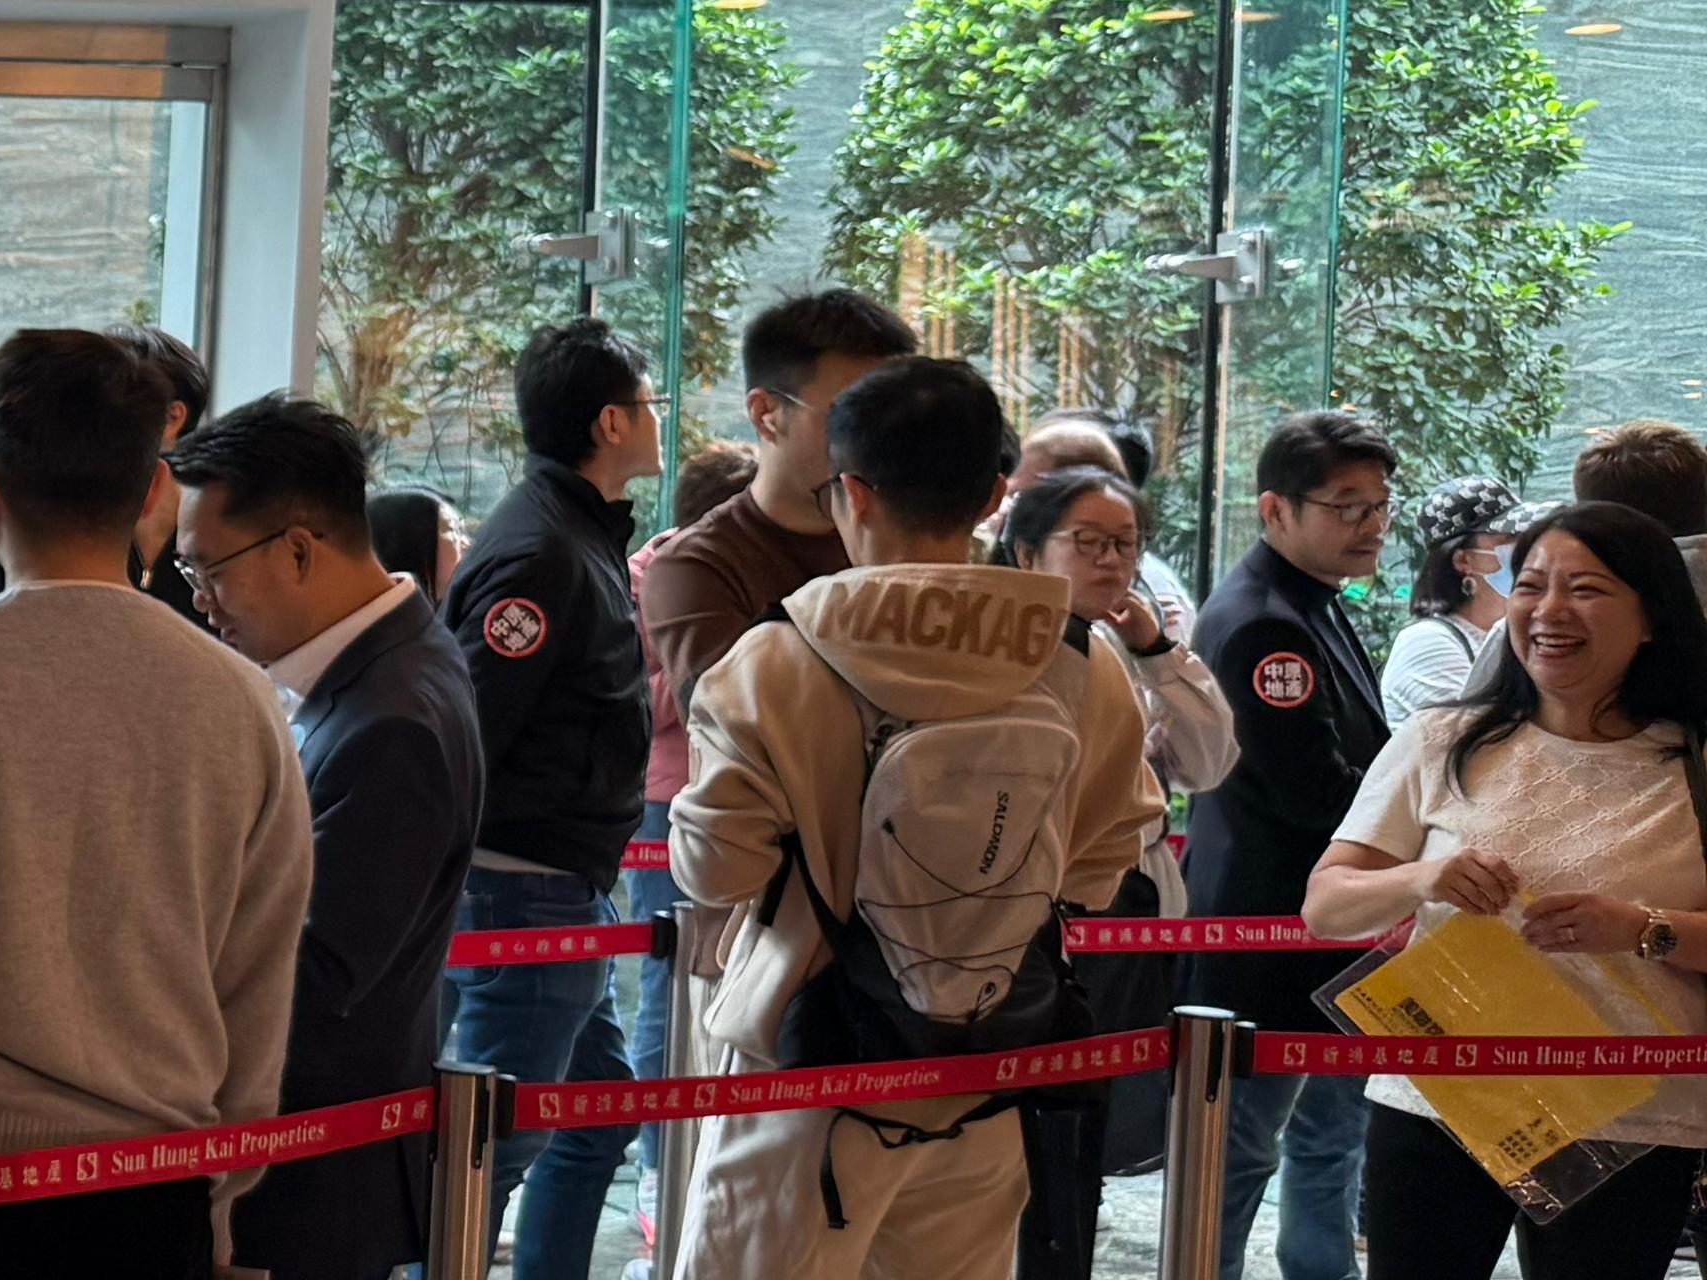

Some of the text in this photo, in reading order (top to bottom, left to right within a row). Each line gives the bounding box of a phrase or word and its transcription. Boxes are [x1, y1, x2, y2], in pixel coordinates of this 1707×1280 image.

[816, 581, 1069, 667] MACKAG
[1492, 1046, 1528, 1066] Sun
[1536, 1046, 1586, 1069] Hung
[1593, 1045, 1626, 1065] Kai
[728, 1066, 941, 1104] Sun Hung Kai Properties
[110, 1120, 325, 1174] Sun Hung Kai Properties
